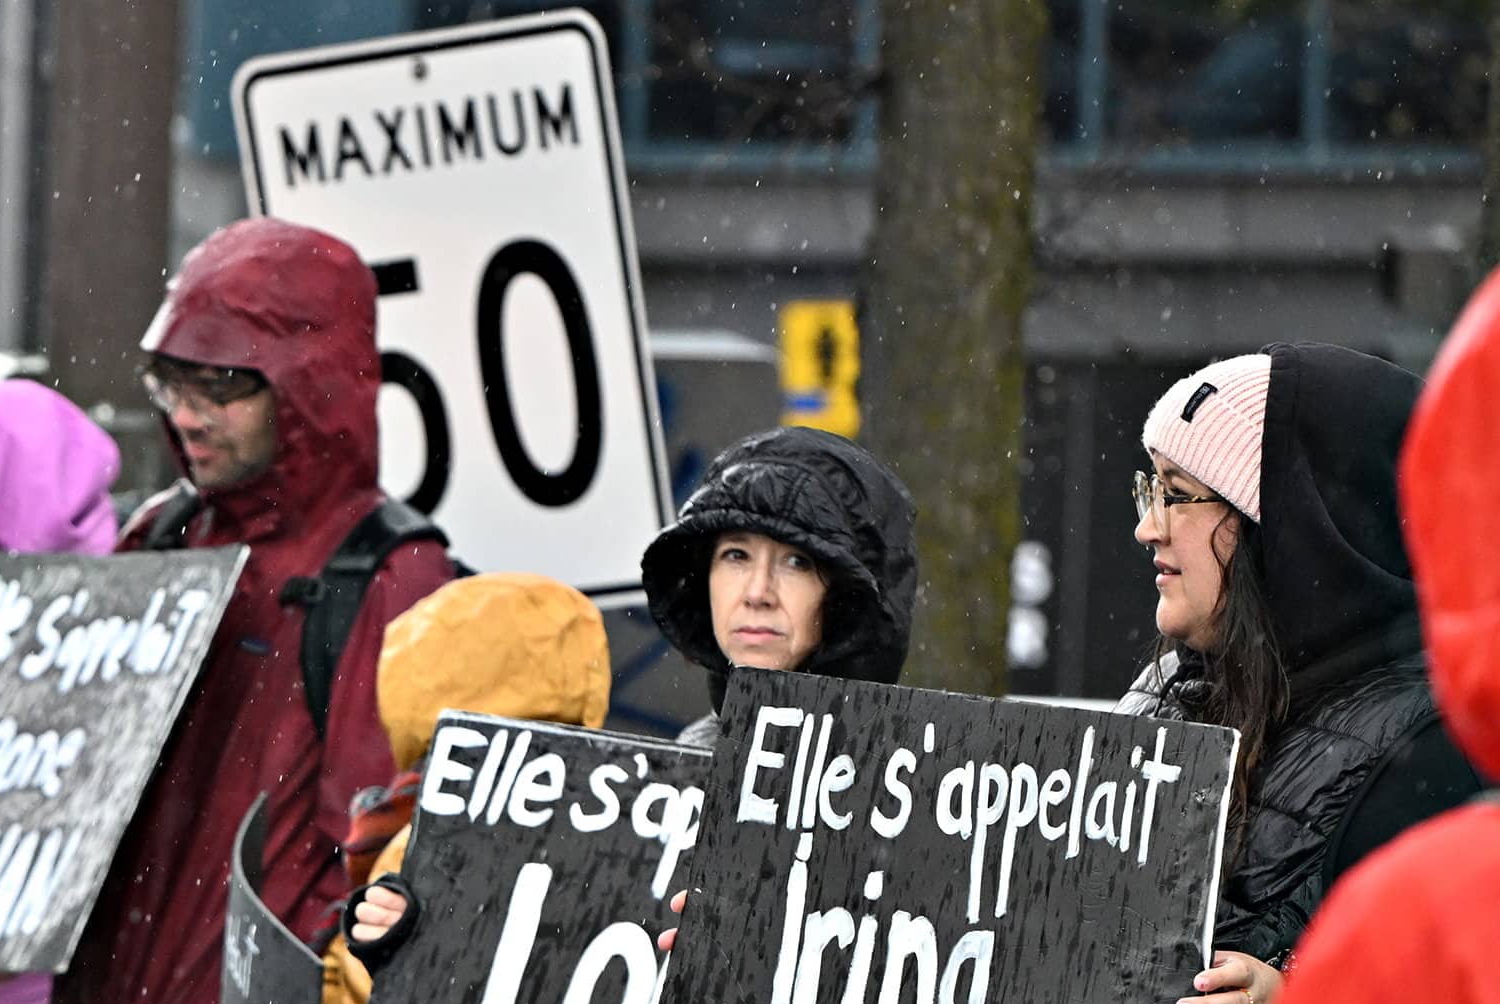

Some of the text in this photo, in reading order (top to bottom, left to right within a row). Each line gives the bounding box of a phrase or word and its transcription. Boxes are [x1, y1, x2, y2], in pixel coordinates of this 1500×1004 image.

[278, 81, 580, 189] MAXIMUM
[420, 725, 567, 828] Elle
[736, 705, 1182, 924] Elle s'appelait
